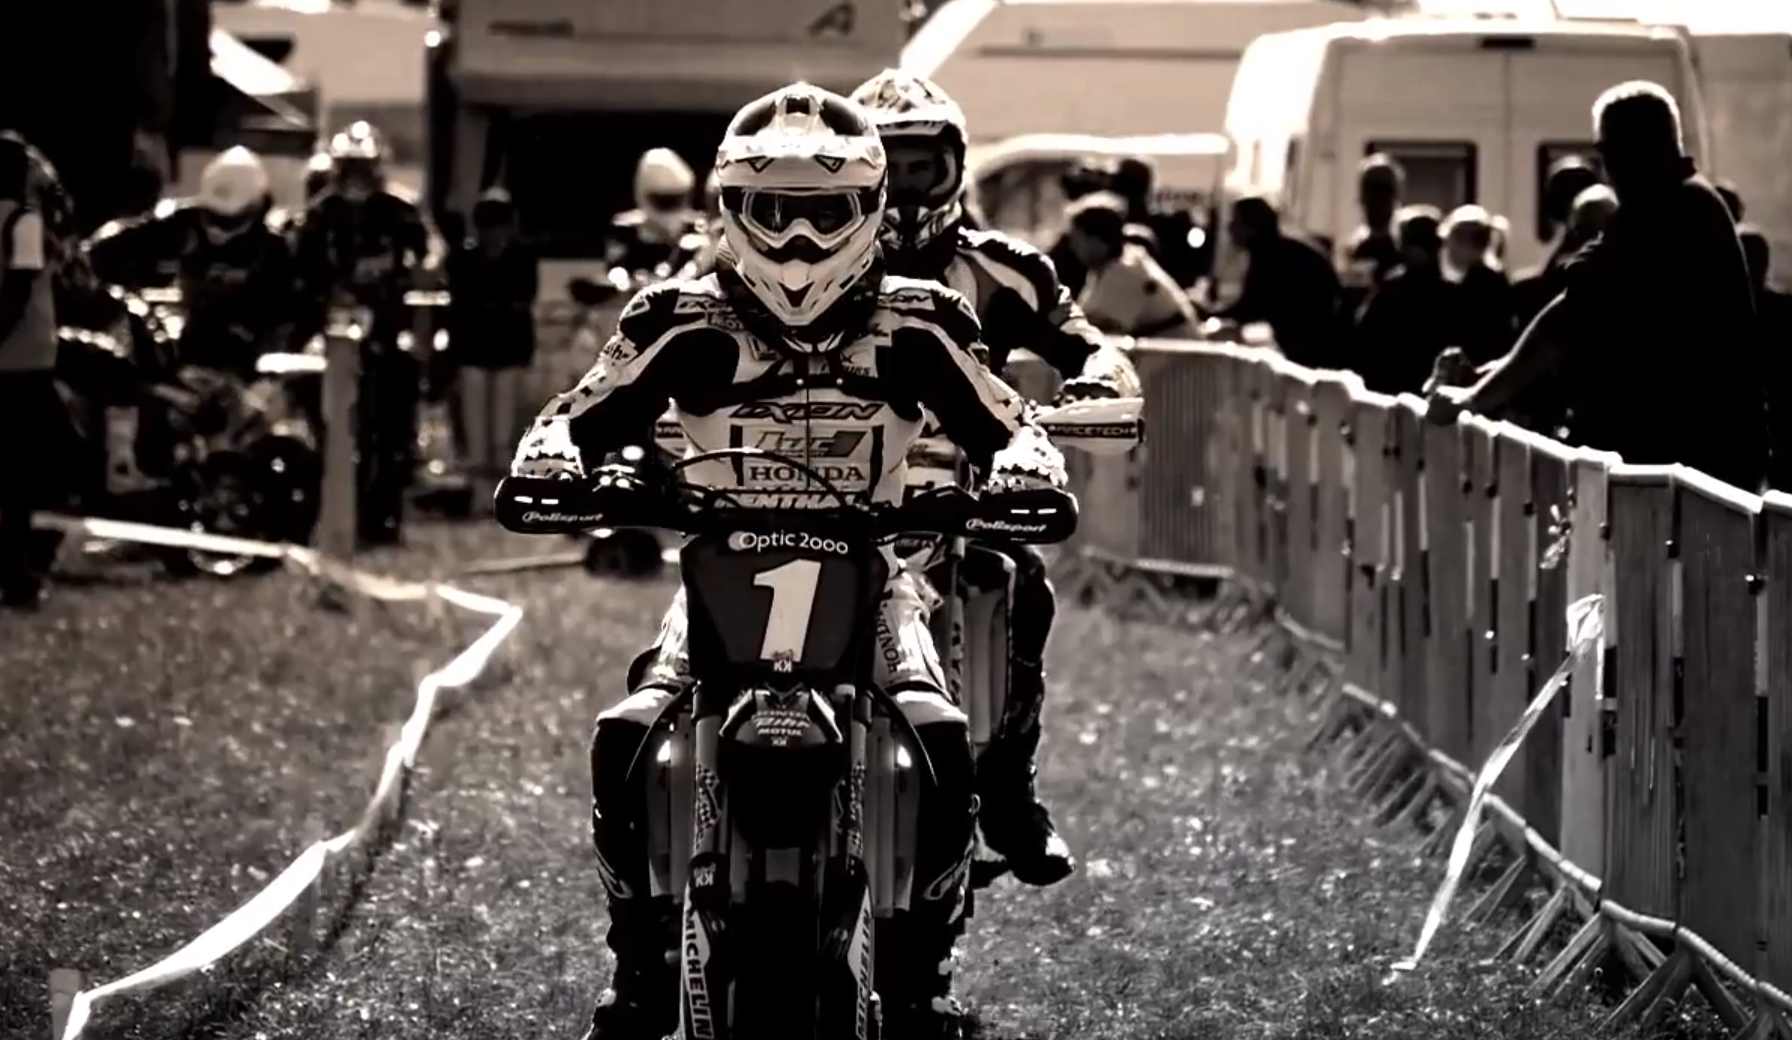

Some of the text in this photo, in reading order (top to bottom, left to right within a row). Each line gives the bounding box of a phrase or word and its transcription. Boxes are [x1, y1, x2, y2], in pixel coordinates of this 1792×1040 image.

[738, 529, 849, 554] Optic 2000
[965, 517, 1047, 532] Polisport
[753, 558, 822, 663] 1
[685, 909, 714, 1036] MICHELIN
